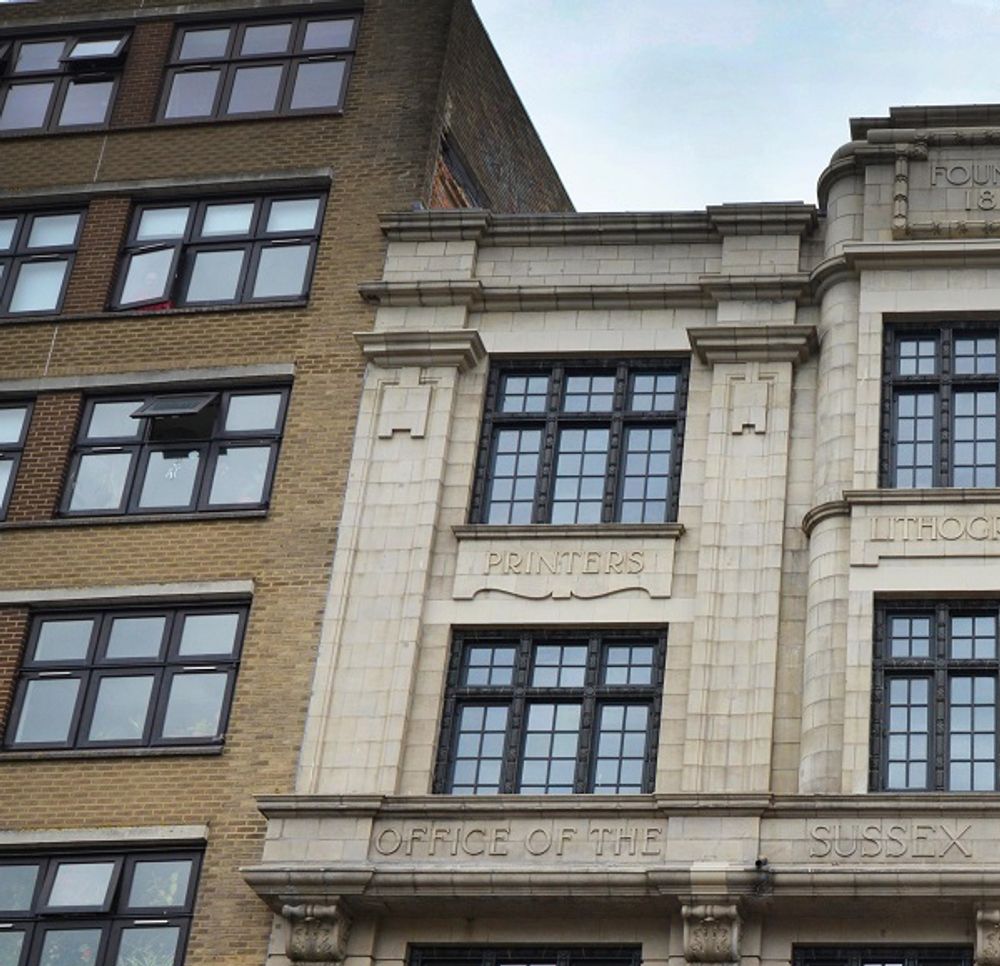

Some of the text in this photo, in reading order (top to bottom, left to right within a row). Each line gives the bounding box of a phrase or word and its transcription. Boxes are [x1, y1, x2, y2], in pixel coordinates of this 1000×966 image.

[484, 551, 645, 575] PRINTERS
[374, 828, 663, 857] OFFICE OF THE
[809, 824, 973, 858] SUSSEX
